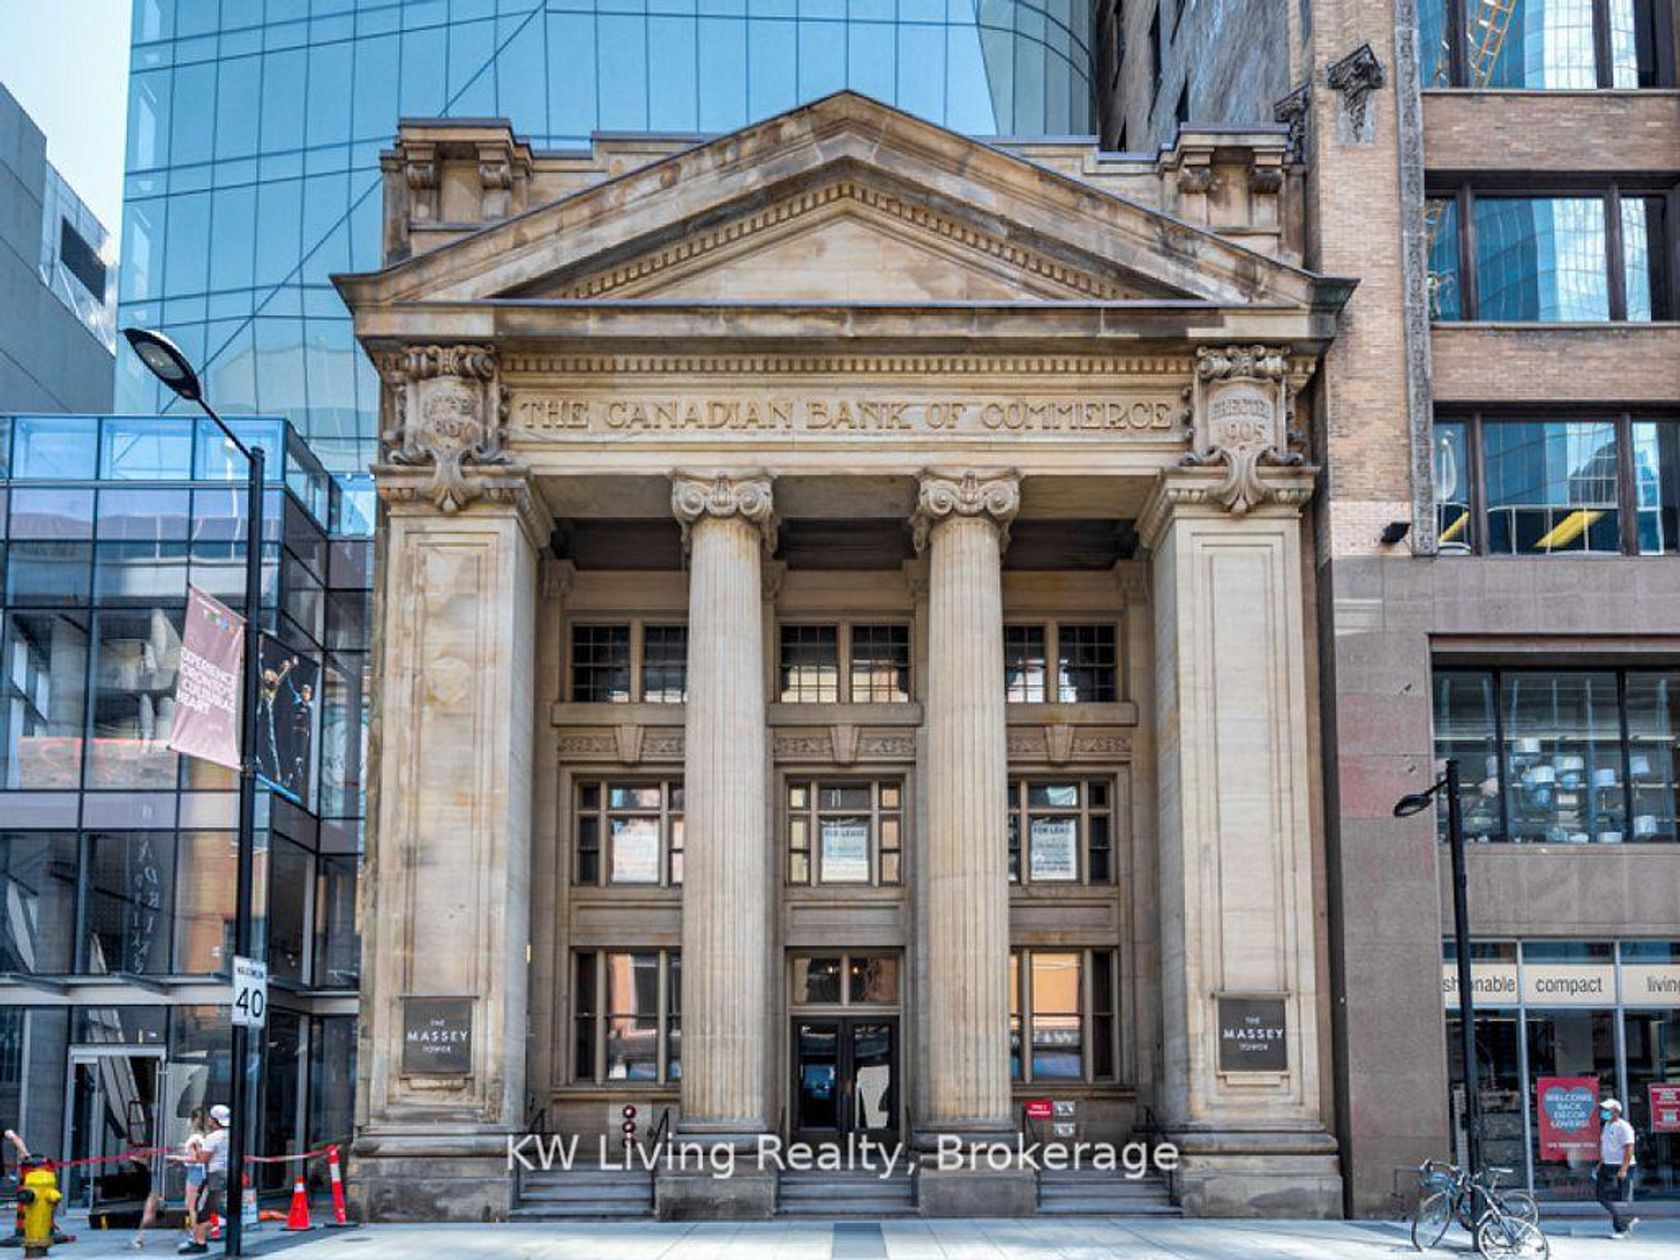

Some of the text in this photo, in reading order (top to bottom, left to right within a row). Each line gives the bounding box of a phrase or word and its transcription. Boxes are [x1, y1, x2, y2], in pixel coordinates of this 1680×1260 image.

[519, 400, 1173, 431] THE CANADIAN BANK OF COMMERCE
[1535, 977, 1603, 996] compact
[1647, 975, 1680, 994] livin
[235, 987, 264, 1018] 40
[406, 1030, 469, 1042] MASSEY
[1223, 1028, 1284, 1040] MASSEY
[1544, 1093, 1594, 1102] WELCOME
